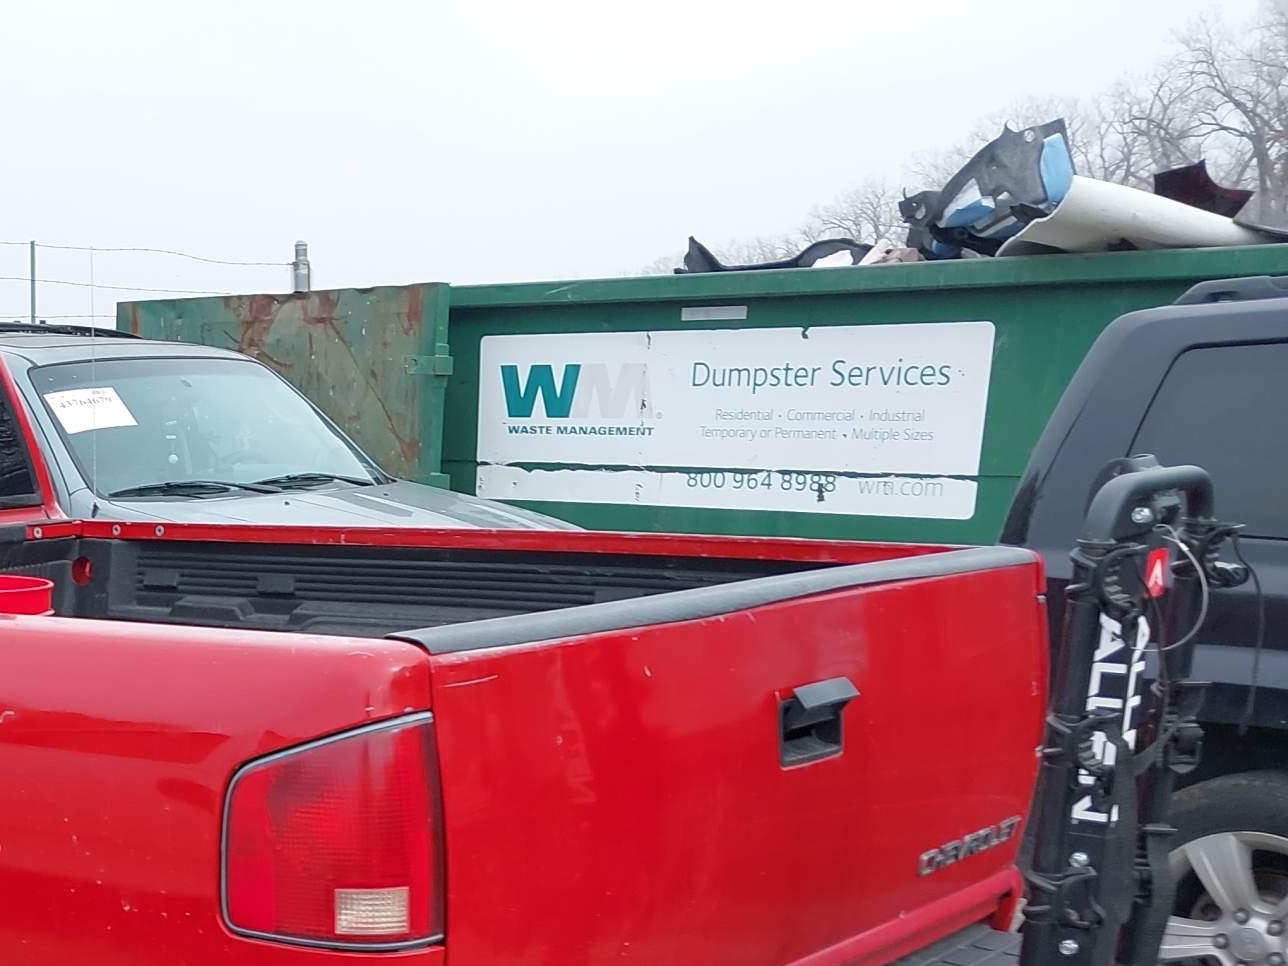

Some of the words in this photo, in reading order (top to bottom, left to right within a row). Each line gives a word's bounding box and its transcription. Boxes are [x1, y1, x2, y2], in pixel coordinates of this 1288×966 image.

[692, 362, 822, 394] Dumpster
[830, 358, 951, 386] Services
[715, 408, 773, 421] Residential
[786, 409, 855, 422] Commercial
[869, 409, 925, 422] Industrial
[507, 425, 552, 435] WASTE
[556, 426, 655, 436] MANAGEMENT
[700, 426, 757, 441] Temporary
[759, 429, 772, 440] or
[774, 427, 837, 440] Permanent
[851, 428, 900, 442] Multiple
[904, 428, 934, 441] Sizes
[686, 472, 726, 488] 800
[732, 472, 773, 490] 964
